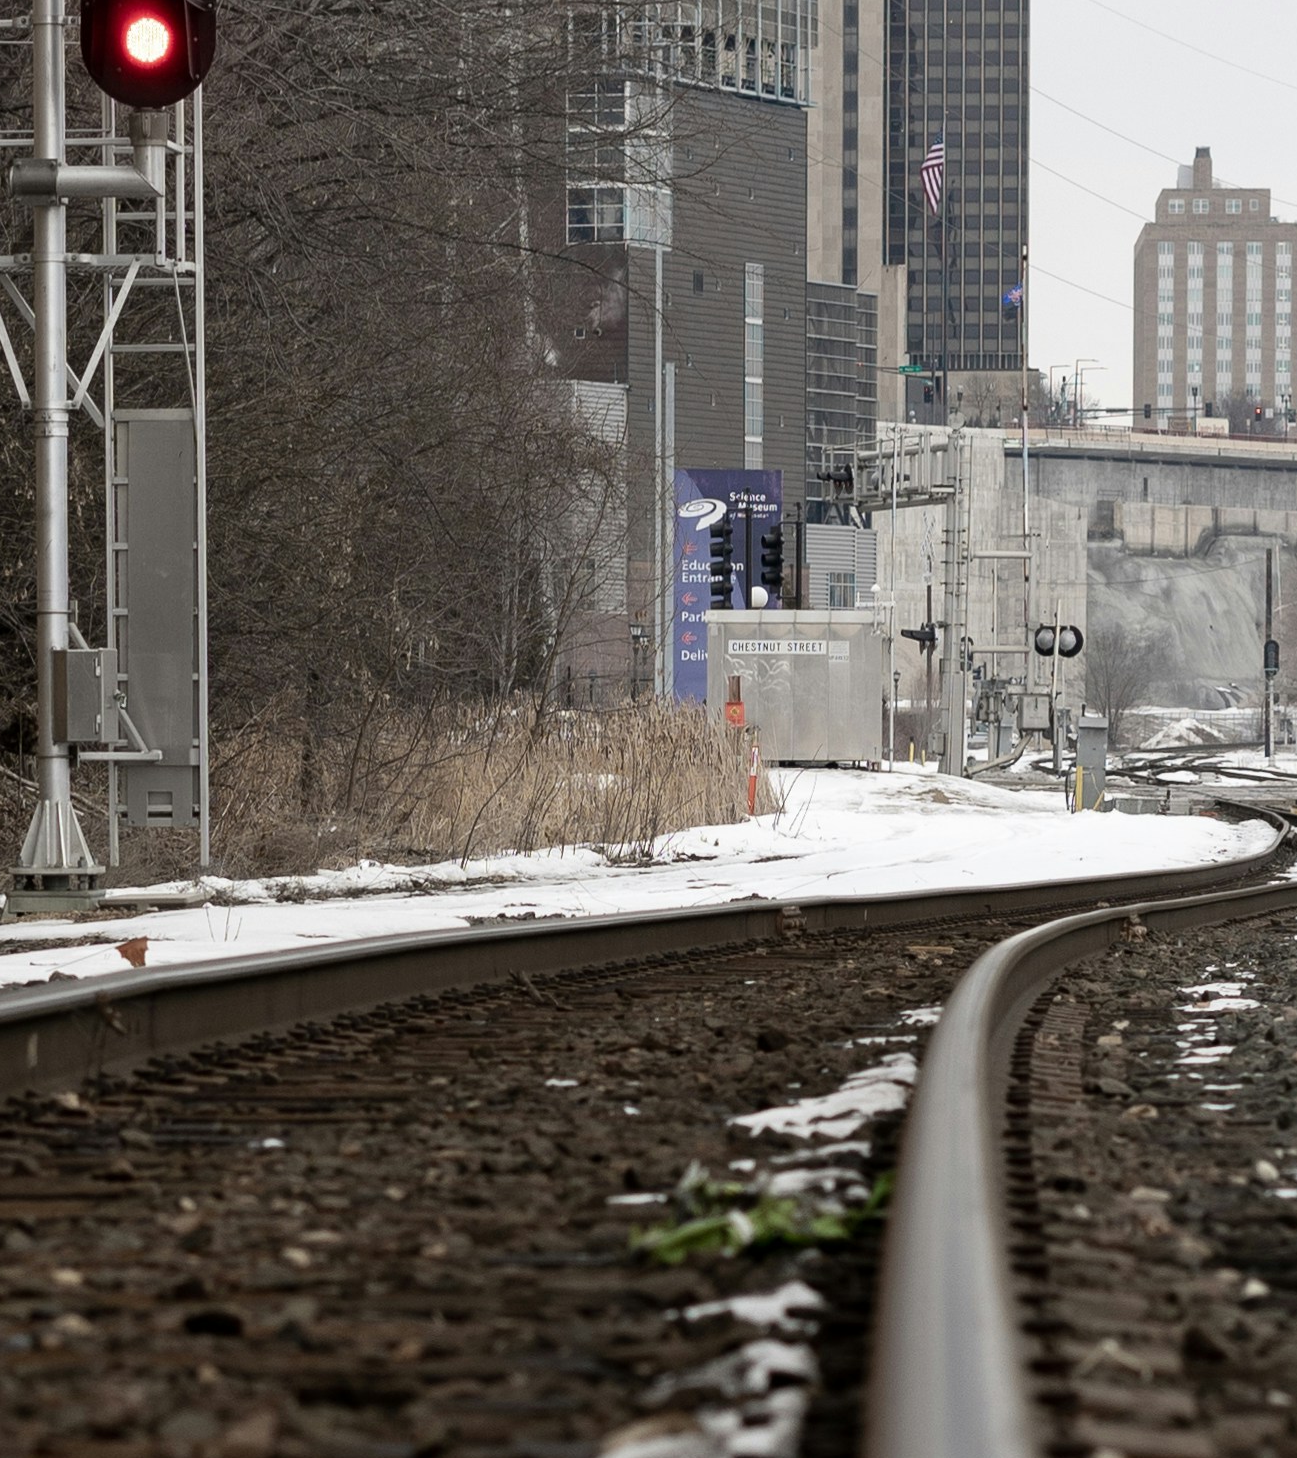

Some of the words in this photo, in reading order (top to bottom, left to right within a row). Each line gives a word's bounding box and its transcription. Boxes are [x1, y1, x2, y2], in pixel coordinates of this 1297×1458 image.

[729, 491, 766, 502] Science
[682, 559, 744, 571] Educon
[682, 572, 737, 583] Entrane
[732, 642, 781, 652] CHESTNUT
[787, 642, 823, 652] STREET
